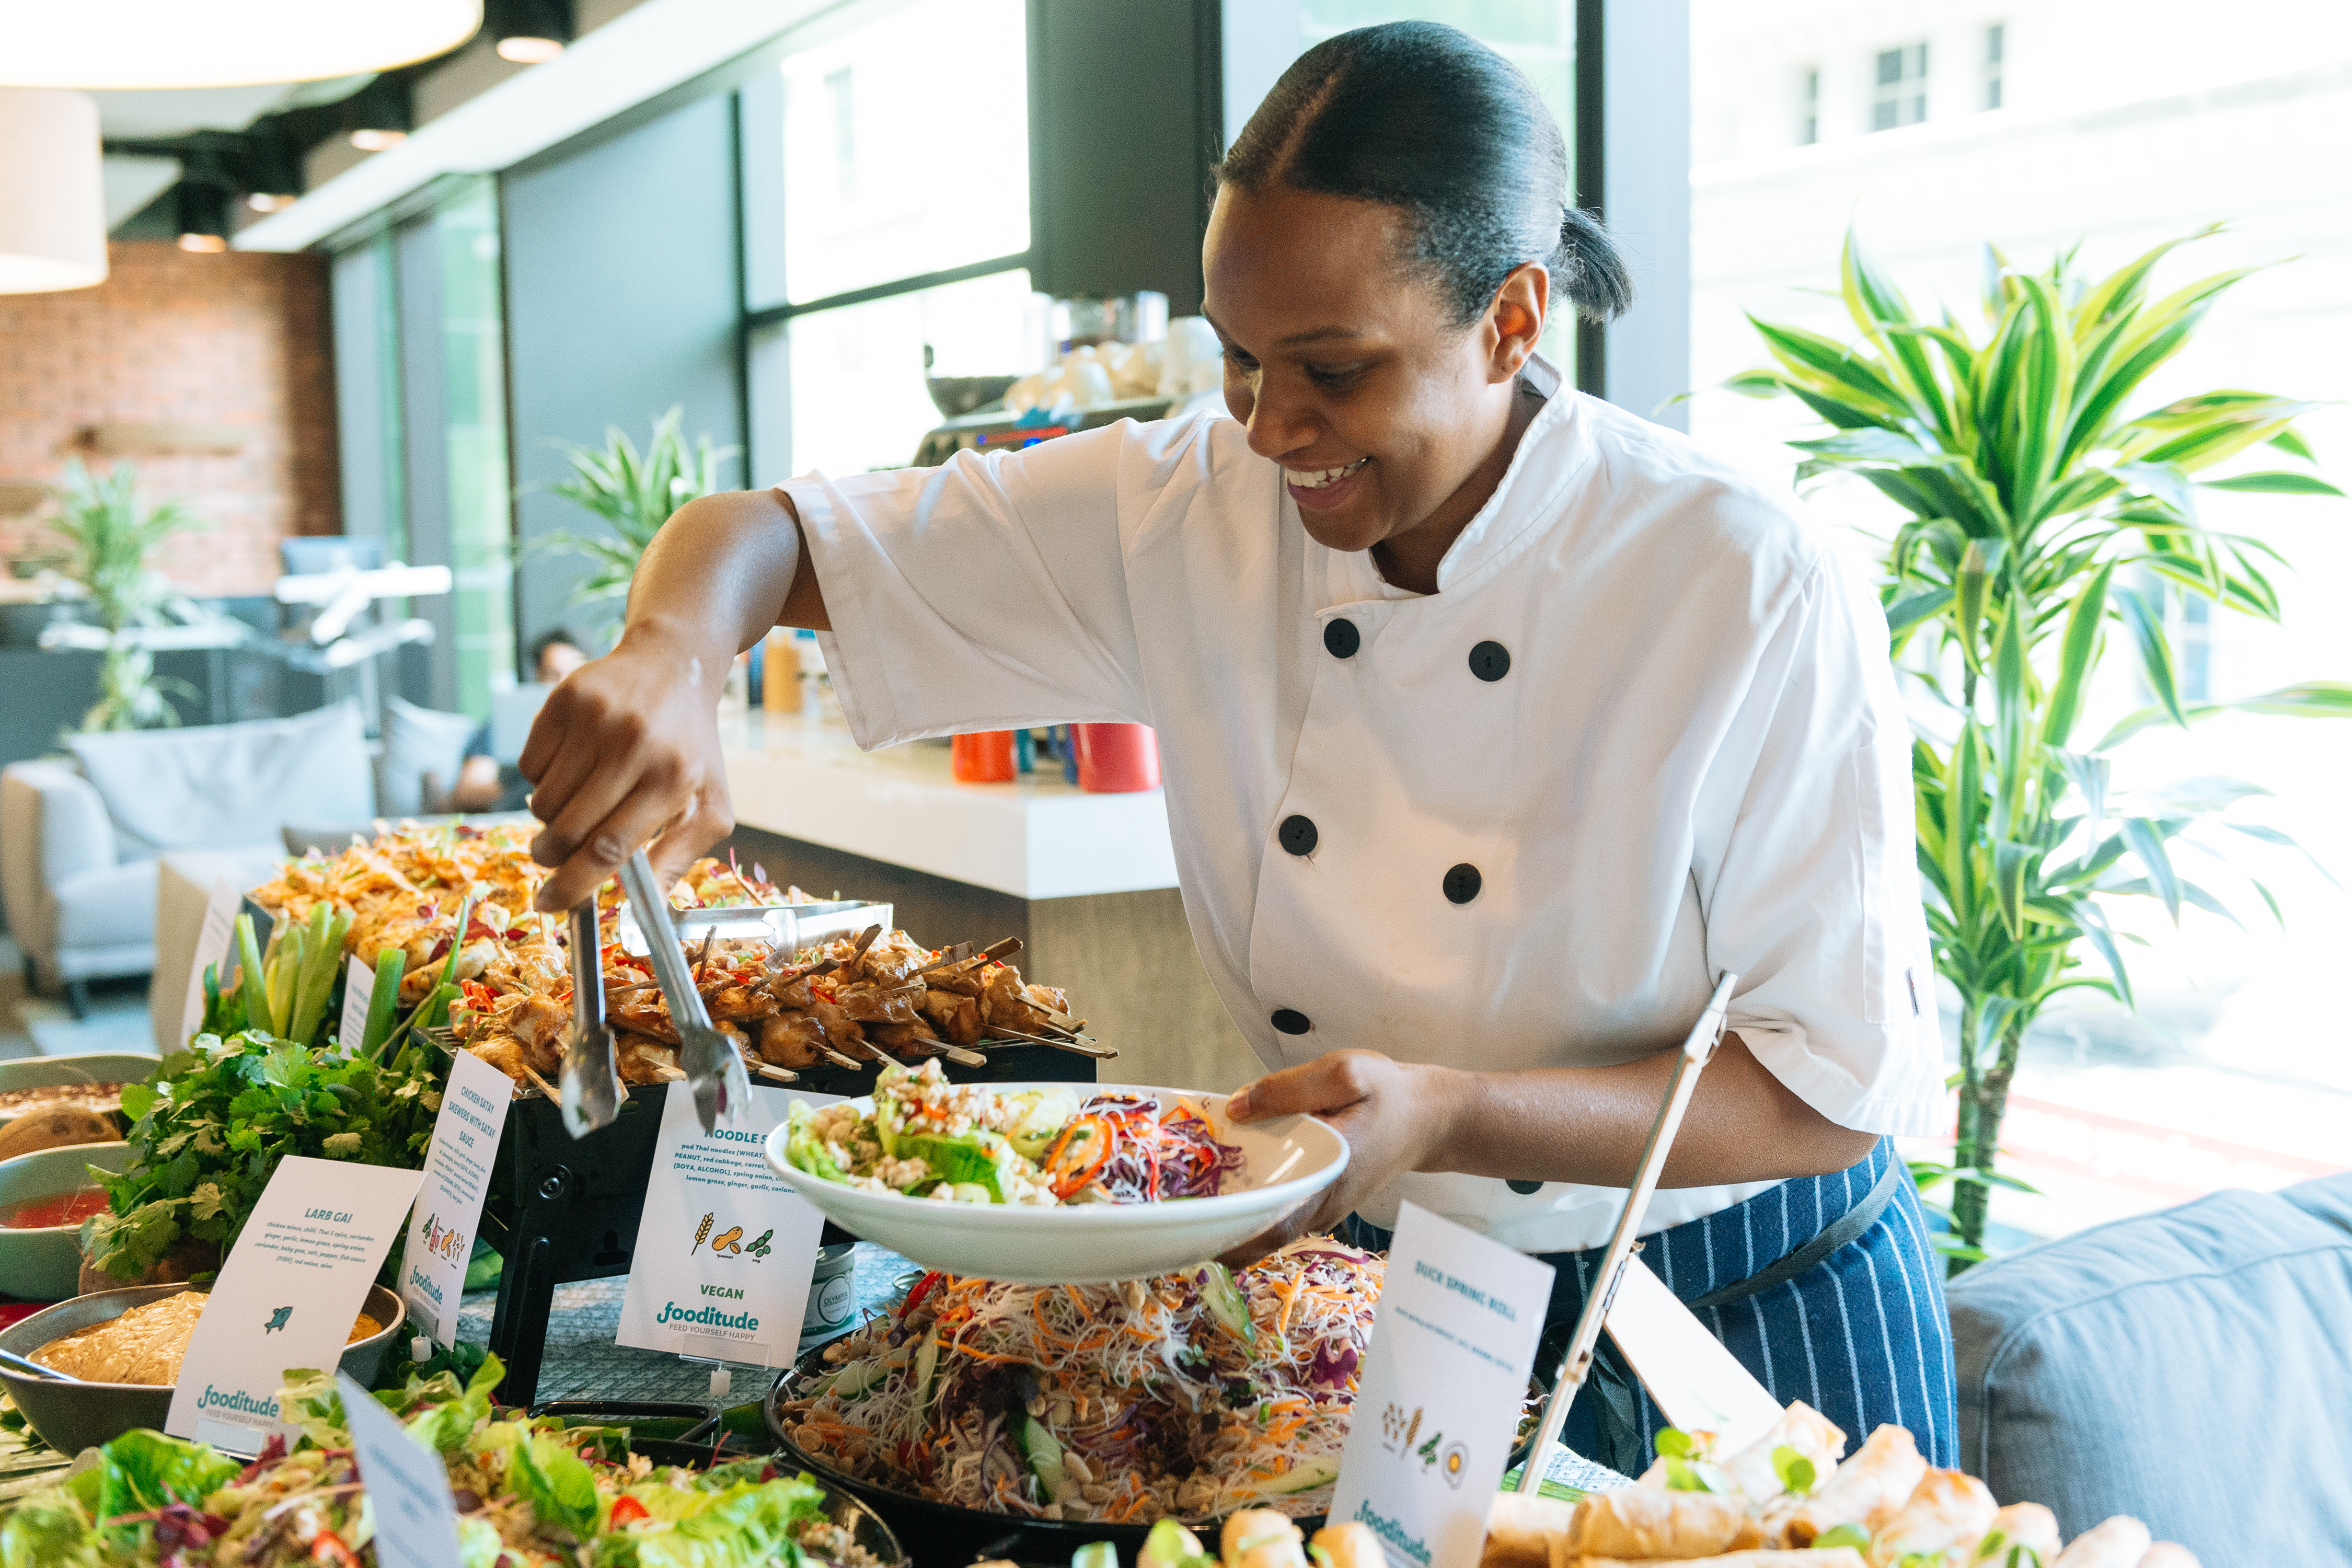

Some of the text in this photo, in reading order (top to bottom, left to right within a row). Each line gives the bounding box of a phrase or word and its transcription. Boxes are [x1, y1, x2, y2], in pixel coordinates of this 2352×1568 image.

[461, 1086, 494, 1114] CHICKEN SATAY
[448, 1101, 496, 1138] SKEWERS WITH SATAY
[459, 1131, 475, 1148] SAUCE
[674, 1152, 702, 1162] PEANUT,
[715, 1158, 743, 1167] cabbage,
[674, 1162, 696, 1171] (SOYA,
[697, 1166, 732, 1176] ALCOHOL),
[727, 1180, 749, 1189] ginger,
[305, 1208, 353, 1224] LARB GAI
[410, 1265, 443, 1305] fooditude
[700, 1284, 744, 1300] VEGAN
[656, 1301, 759, 1331] fooditude
[689, 1326, 727, 1337] YOURSELF
[729, 1331, 755, 1341] HAPPY
[197, 1384, 279, 1417] fooditude
